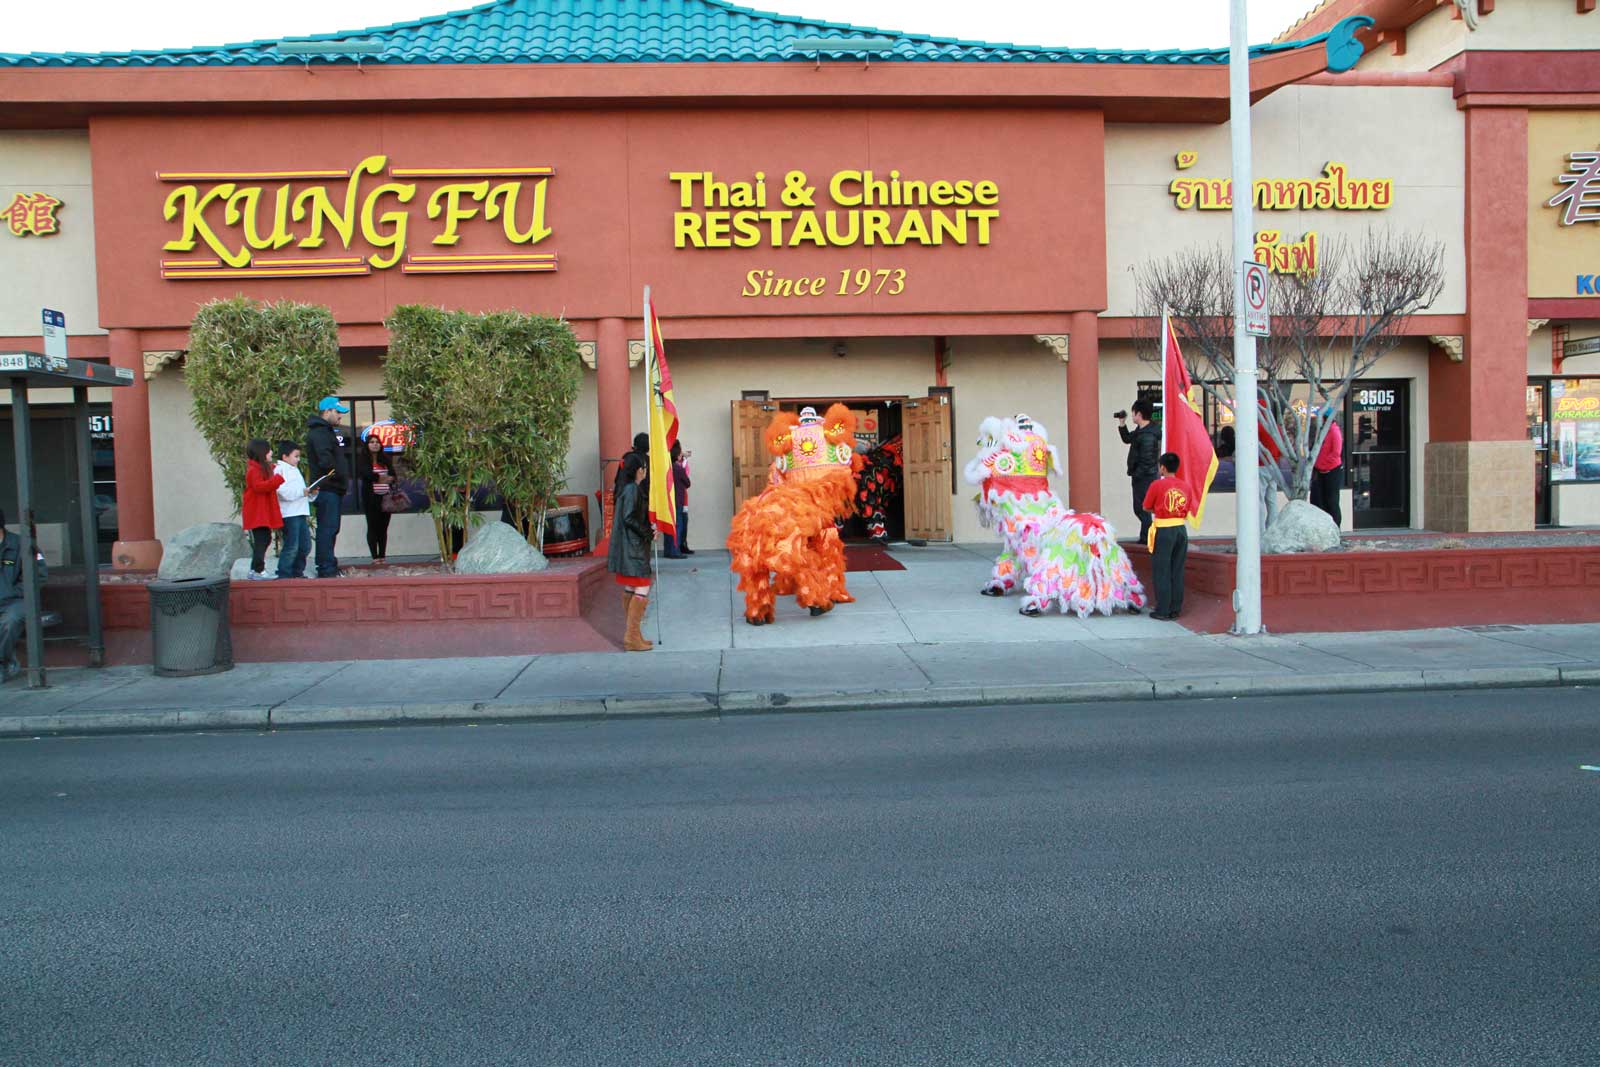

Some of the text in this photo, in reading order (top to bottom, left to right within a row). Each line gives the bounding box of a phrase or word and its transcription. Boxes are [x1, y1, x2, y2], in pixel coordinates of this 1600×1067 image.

[669, 170, 999, 208] Thai & Chinese
[1170, 151, 1394, 210] ร้านาหารไทย
[0, 192, 60, 236] 館
[162, 154, 553, 269] KUNG FU
[673, 209, 1000, 248] RESTAURANT
[741, 268, 907, 298] Since 1973
[0, 356, 24, 368] 848
[1360, 389, 1395, 405] 3505
[1558, 397, 1600, 411] DVD
